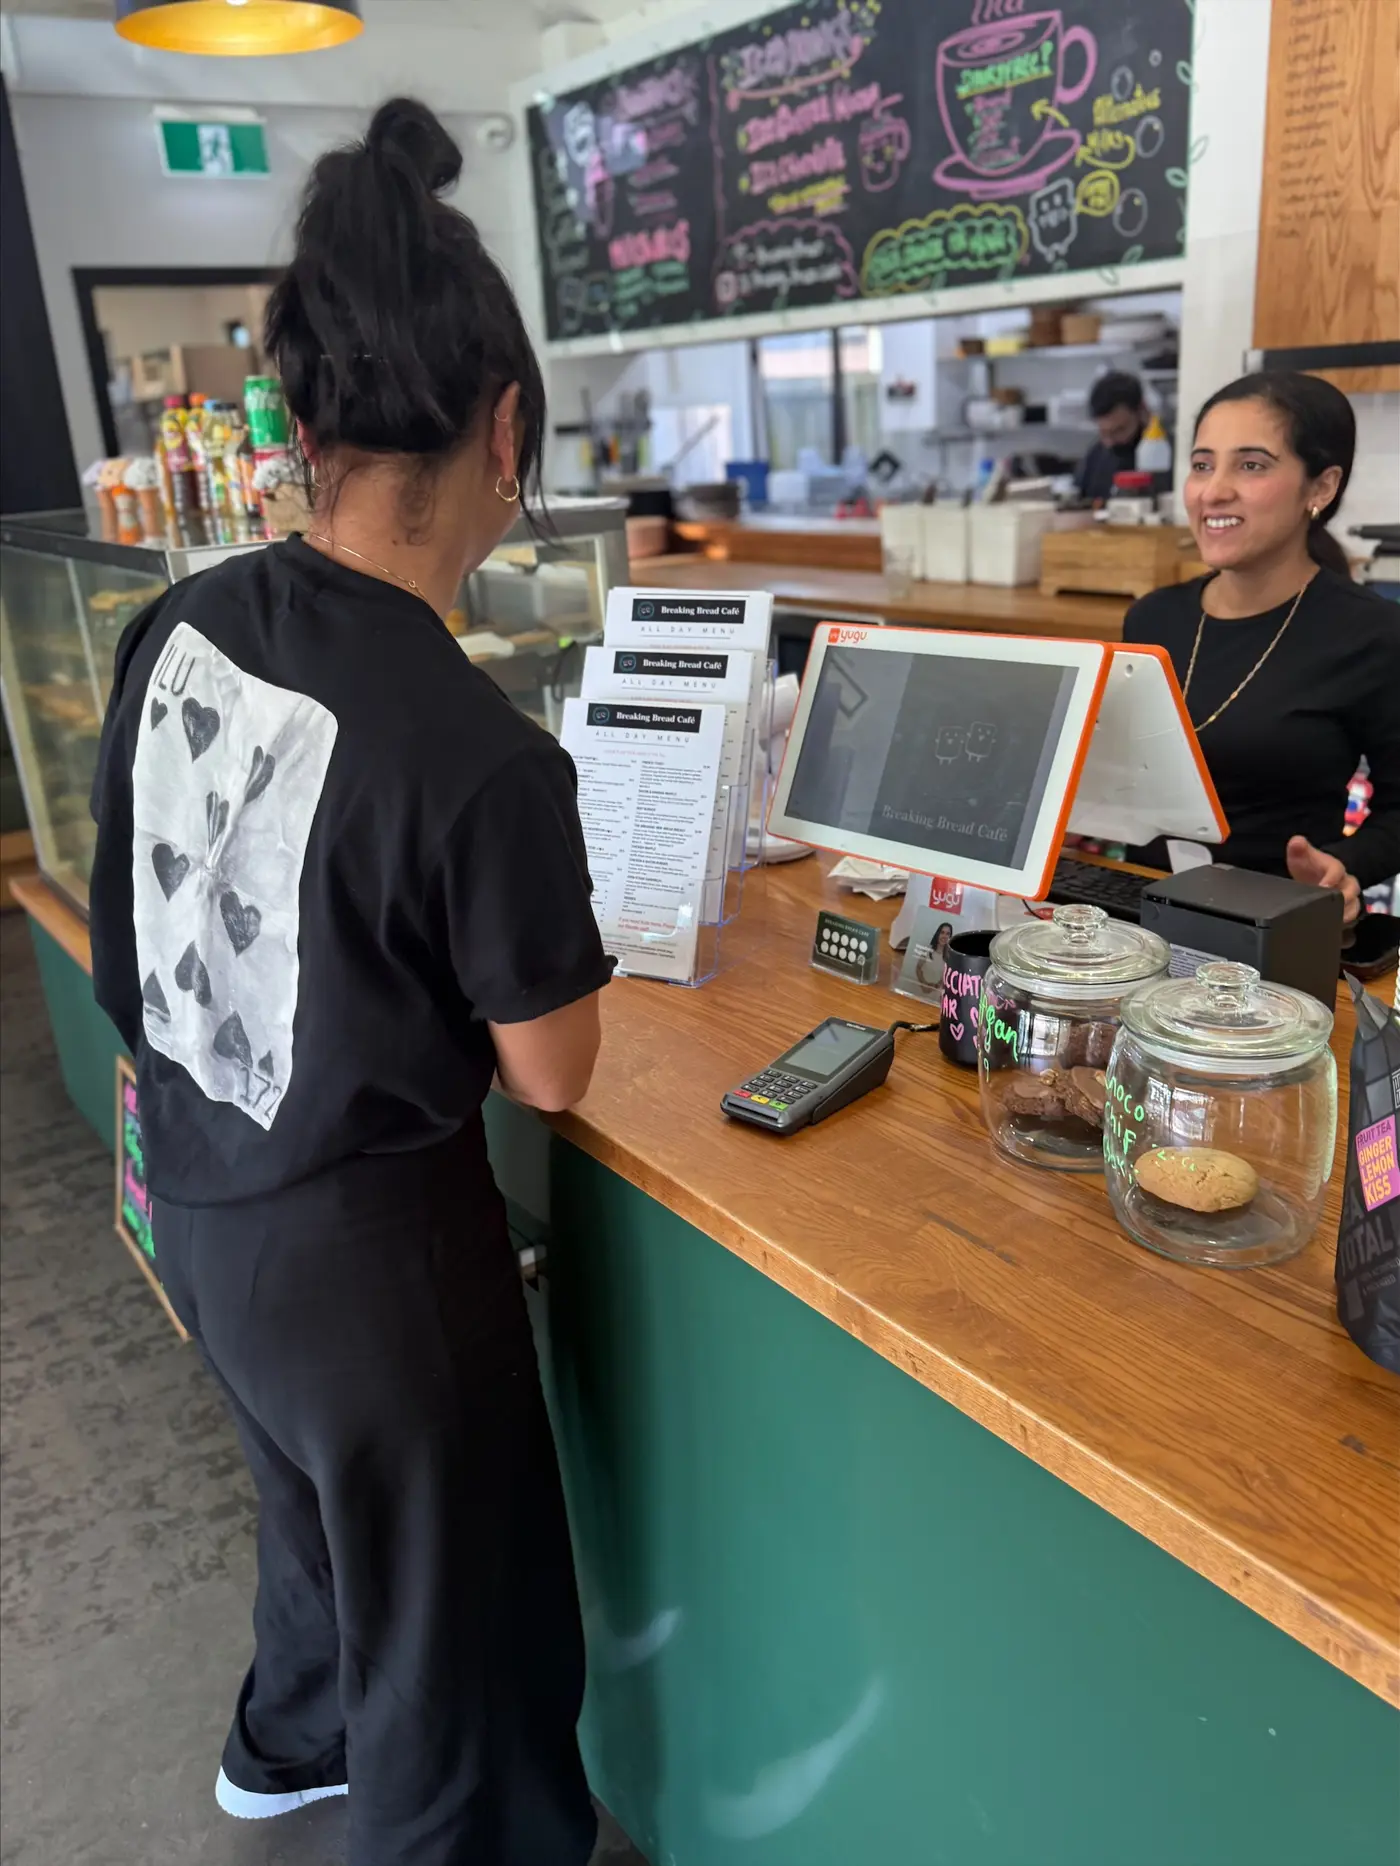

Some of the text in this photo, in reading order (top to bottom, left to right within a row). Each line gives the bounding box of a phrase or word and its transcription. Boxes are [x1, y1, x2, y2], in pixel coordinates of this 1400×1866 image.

[661, 606, 740, 616] Breaking Bread Café
[840, 630, 867, 644] yugu
[643, 659, 722, 670] Breaking Bread Café
[684, 681, 717, 689] MENU
[616, 711, 696, 725] Breaking Bread Café
[625, 732, 647, 740] DAY
[657, 734, 690, 743] MENU
[882, 804, 1008, 842] Breaking Bread Café
[932, 889, 961, 909] yugu
[1357, 1119, 1393, 1148] FRUIT TEA
[1358, 1135, 1393, 1167] GINGER
[1360, 1156, 1396, 1184] LEMON
[1364, 1176, 1393, 1206] KISS
[1340, 1216, 1394, 1277] TOTAL
